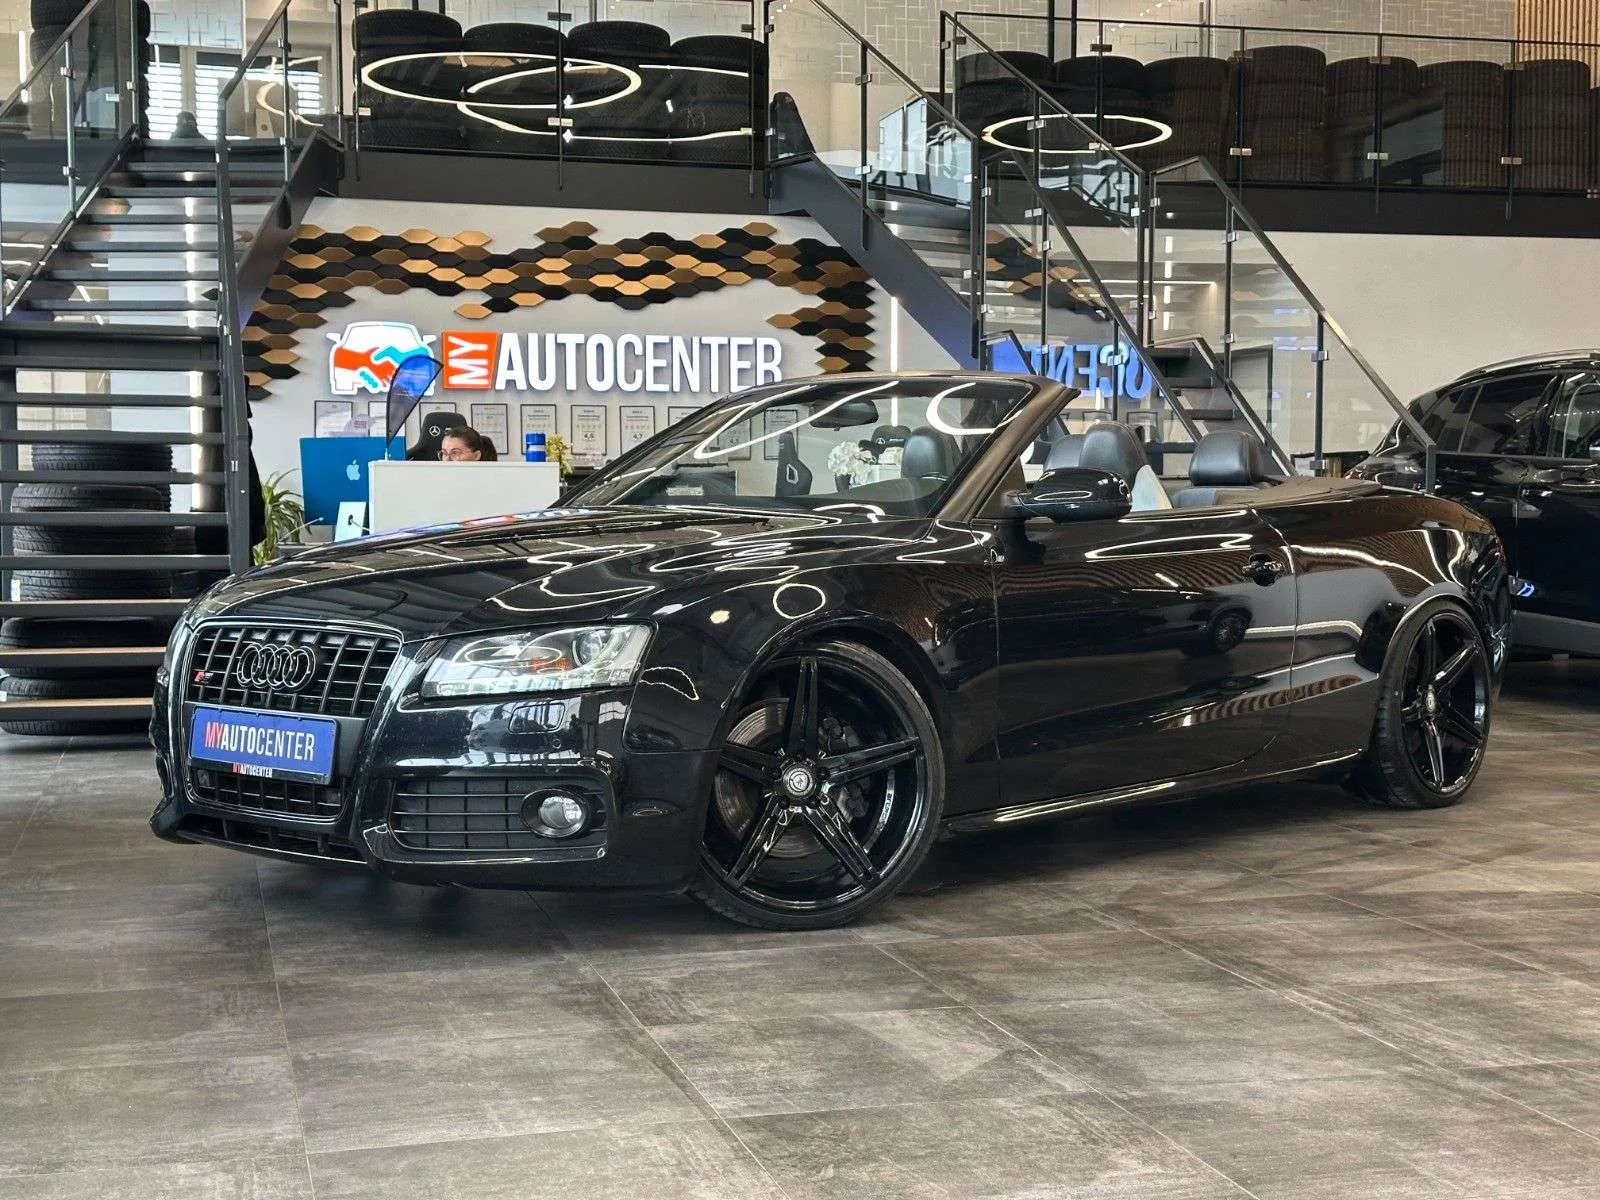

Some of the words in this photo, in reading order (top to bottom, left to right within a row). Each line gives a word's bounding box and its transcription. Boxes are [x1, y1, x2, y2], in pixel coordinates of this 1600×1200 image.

[448, 336, 489, 385] MY
[495, 332, 783, 393] AUTOCENTER
[204, 721, 315, 761] MYAUTOCENTER
